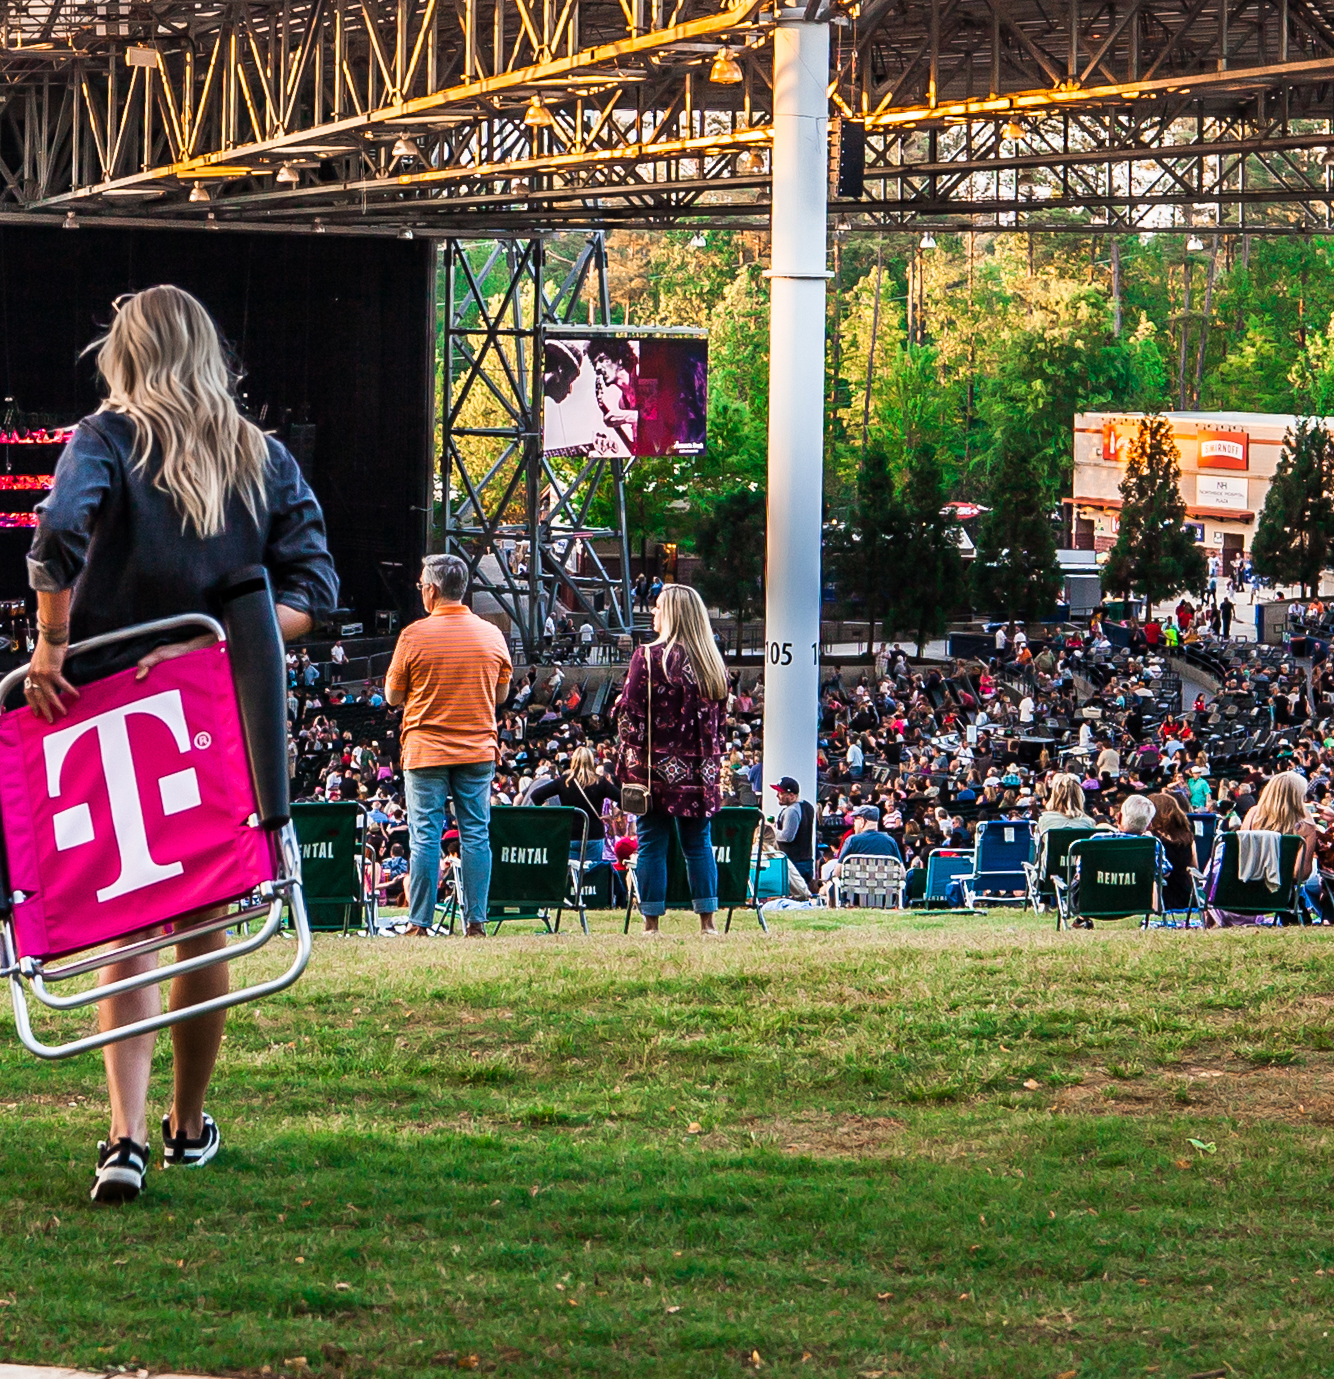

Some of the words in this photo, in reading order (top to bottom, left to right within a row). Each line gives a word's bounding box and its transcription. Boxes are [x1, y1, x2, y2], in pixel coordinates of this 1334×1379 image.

[1205, 443, 1238, 455] SMIRNOFF
[43, 689, 201, 903] T
[299, 842, 334, 859] NTAL
[501, 847, 548, 864] RENTAL
[711, 846, 731, 863] TAL
[1097, 871, 1136, 885] RENTAL
